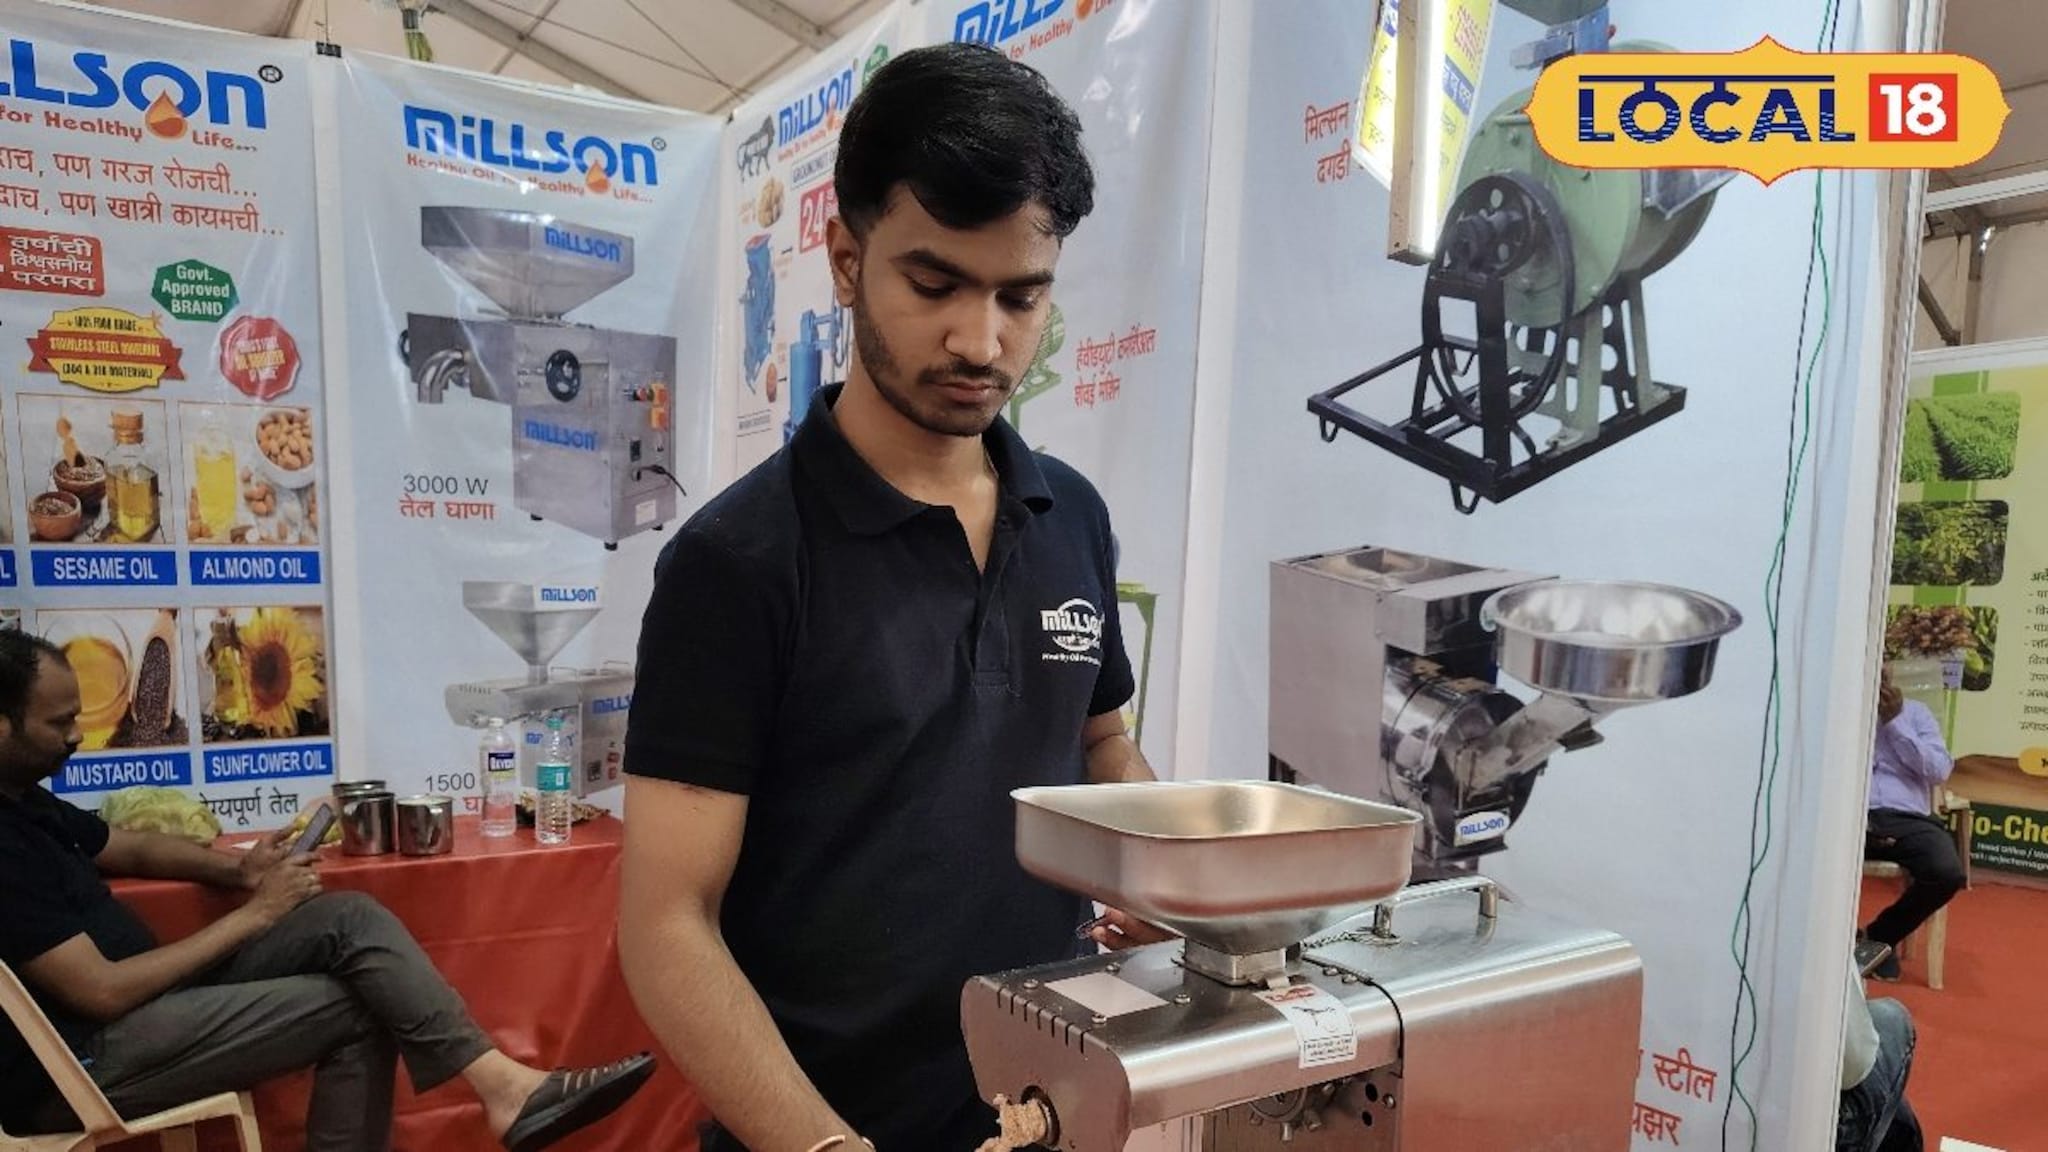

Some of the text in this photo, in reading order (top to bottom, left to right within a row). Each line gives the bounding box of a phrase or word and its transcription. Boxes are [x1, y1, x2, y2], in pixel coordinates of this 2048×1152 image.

[1029, 18, 1074, 50] Healthy
[44, 111, 143, 142] Healthy
[1304, 102, 1350, 144] मिल्सन
[53, 153, 91, 179] पण
[101, 158, 154, 186] गरज
[1317, 139, 1352, 183] दगडी
[58, 191, 97, 217] पण
[105, 192, 163, 224] खात्री
[801, 190, 826, 249] 24
[176, 264, 214, 281] Govt.
[161, 279, 231, 298] Approved
[171, 299, 223, 316] BRAND
[96, 339, 120, 355] STEEL
[403, 474, 489, 496] 3000 W
[399, 493, 495, 520] तेल घाणा
[53, 557, 158, 580] SESAME OIL
[202, 557, 307, 579] ALMOND OIL
[65, 760, 180, 787] MUSTARD OIL
[212, 750, 327, 777] SUNFLOWER OIL
[425, 772, 475, 793] 1500
[268, 785, 299, 815] तेल
[1652, 1047, 1718, 1102] स्टील
